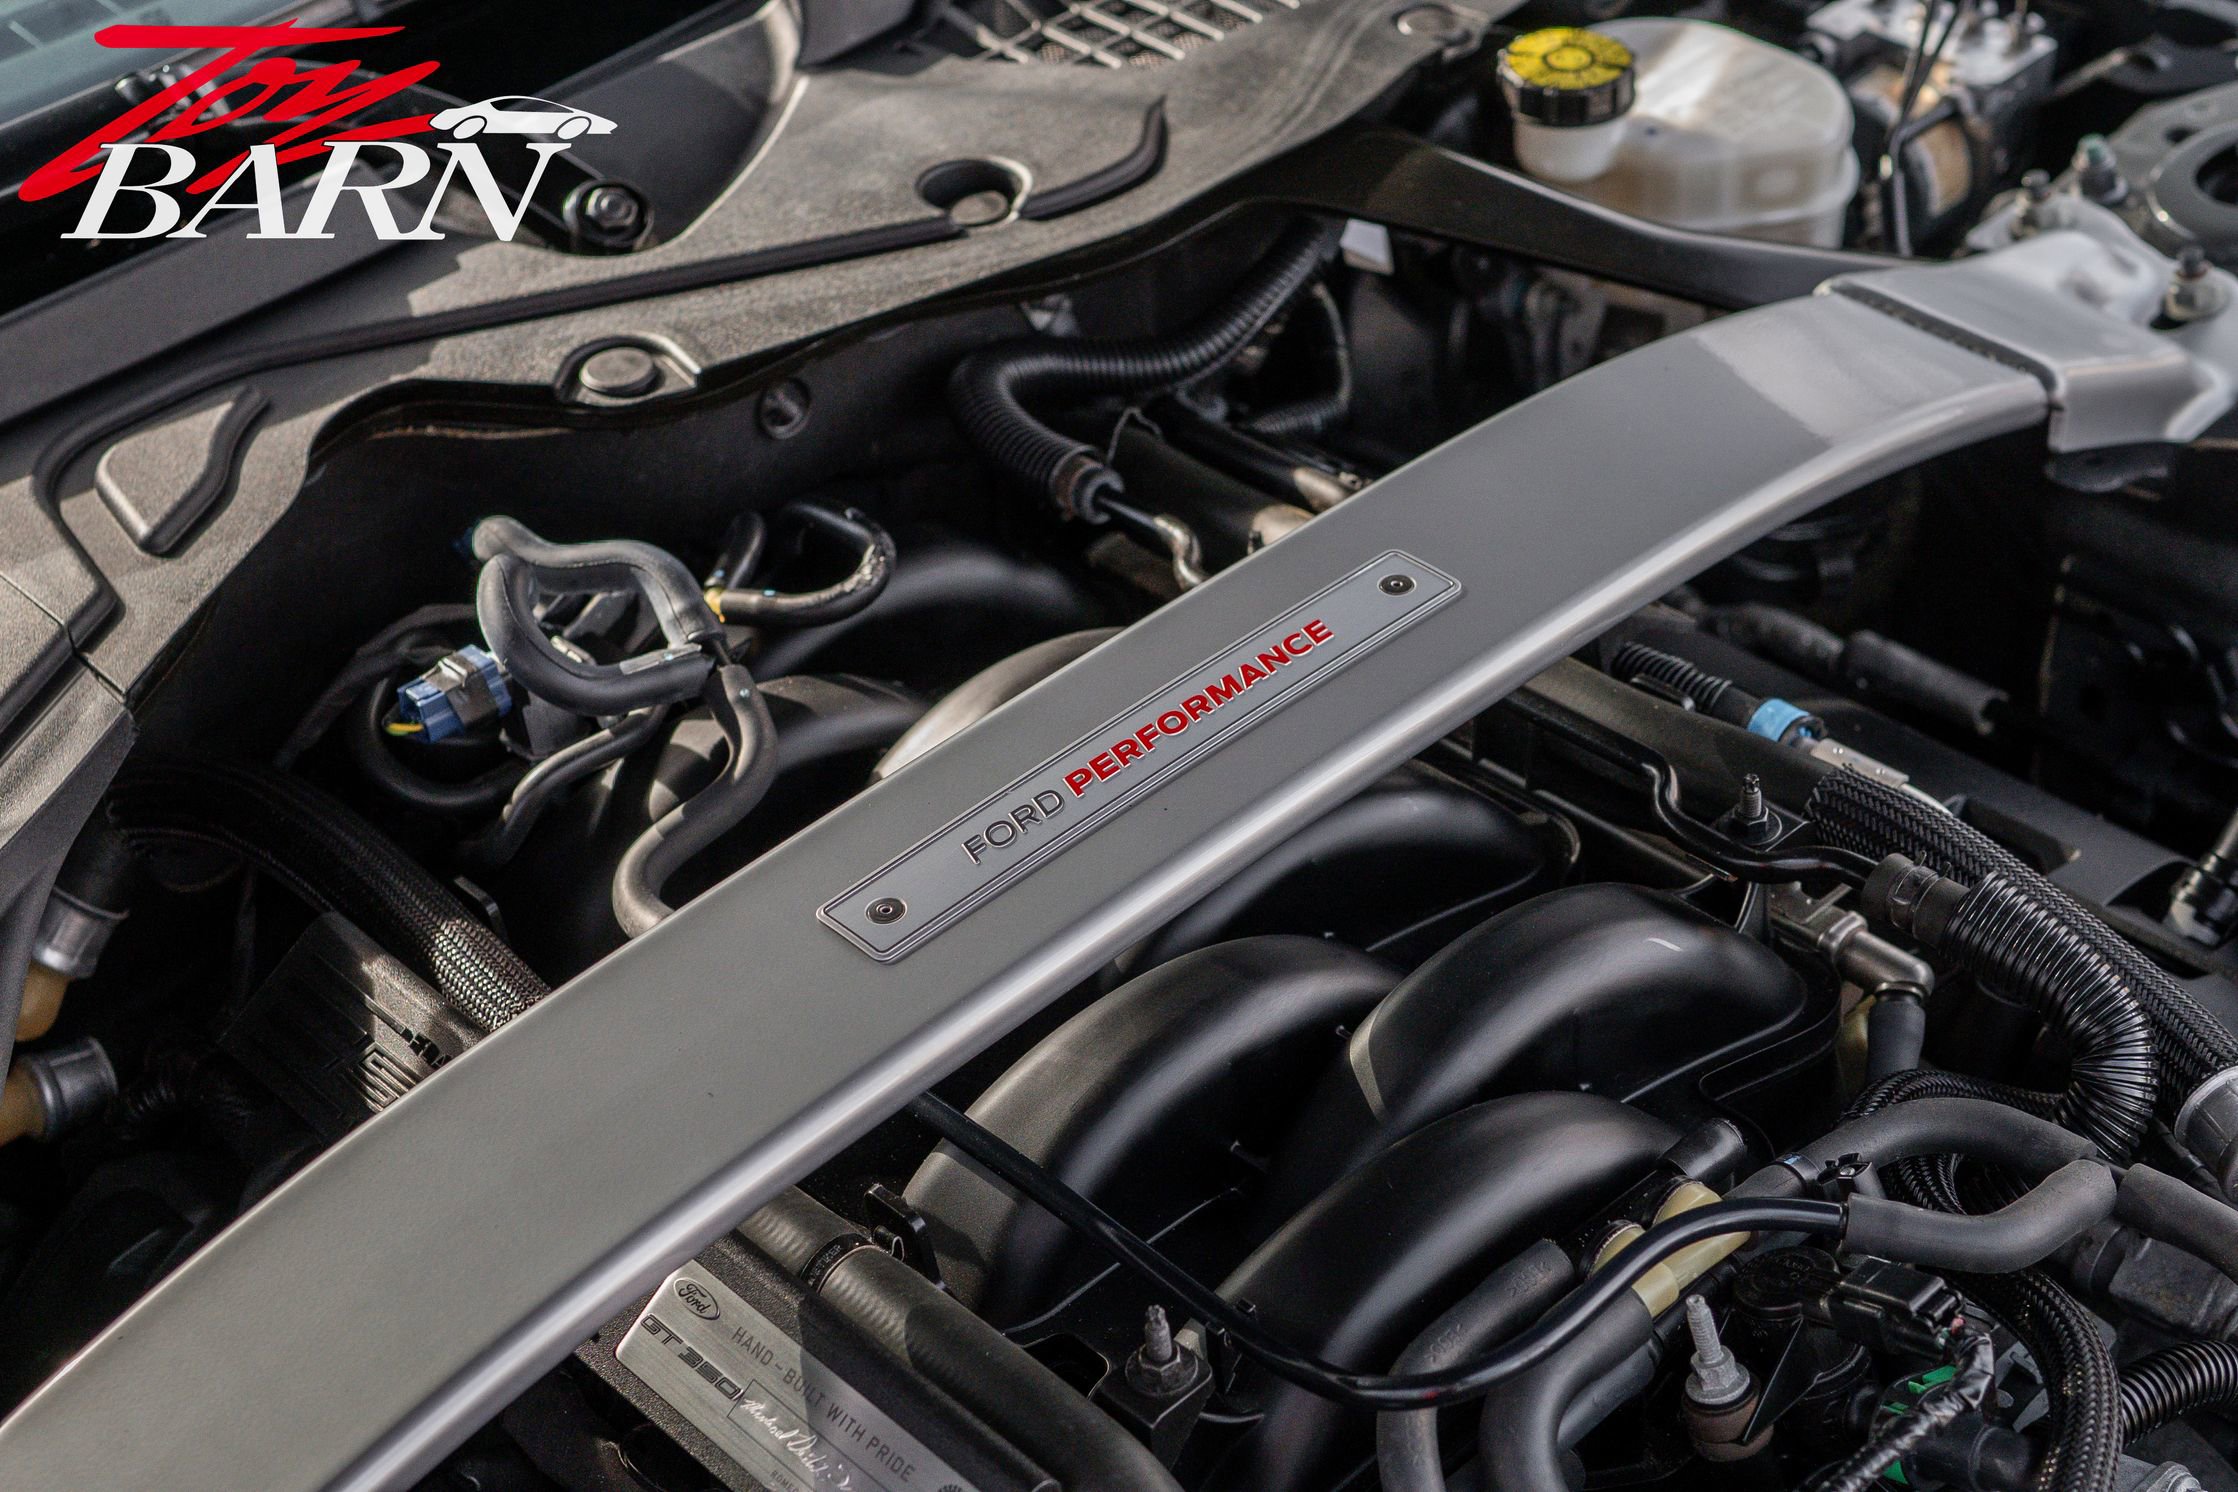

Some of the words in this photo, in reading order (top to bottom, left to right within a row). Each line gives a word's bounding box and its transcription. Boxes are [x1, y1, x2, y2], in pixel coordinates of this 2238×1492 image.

[961, 788, 1066, 866] FORD
[1062, 618, 1335, 799] PERFORMANCE
[678, 1283, 712, 1314] Ford
[826, 1402, 867, 1443] WITH
[865, 1436, 916, 1483] PRIDE
